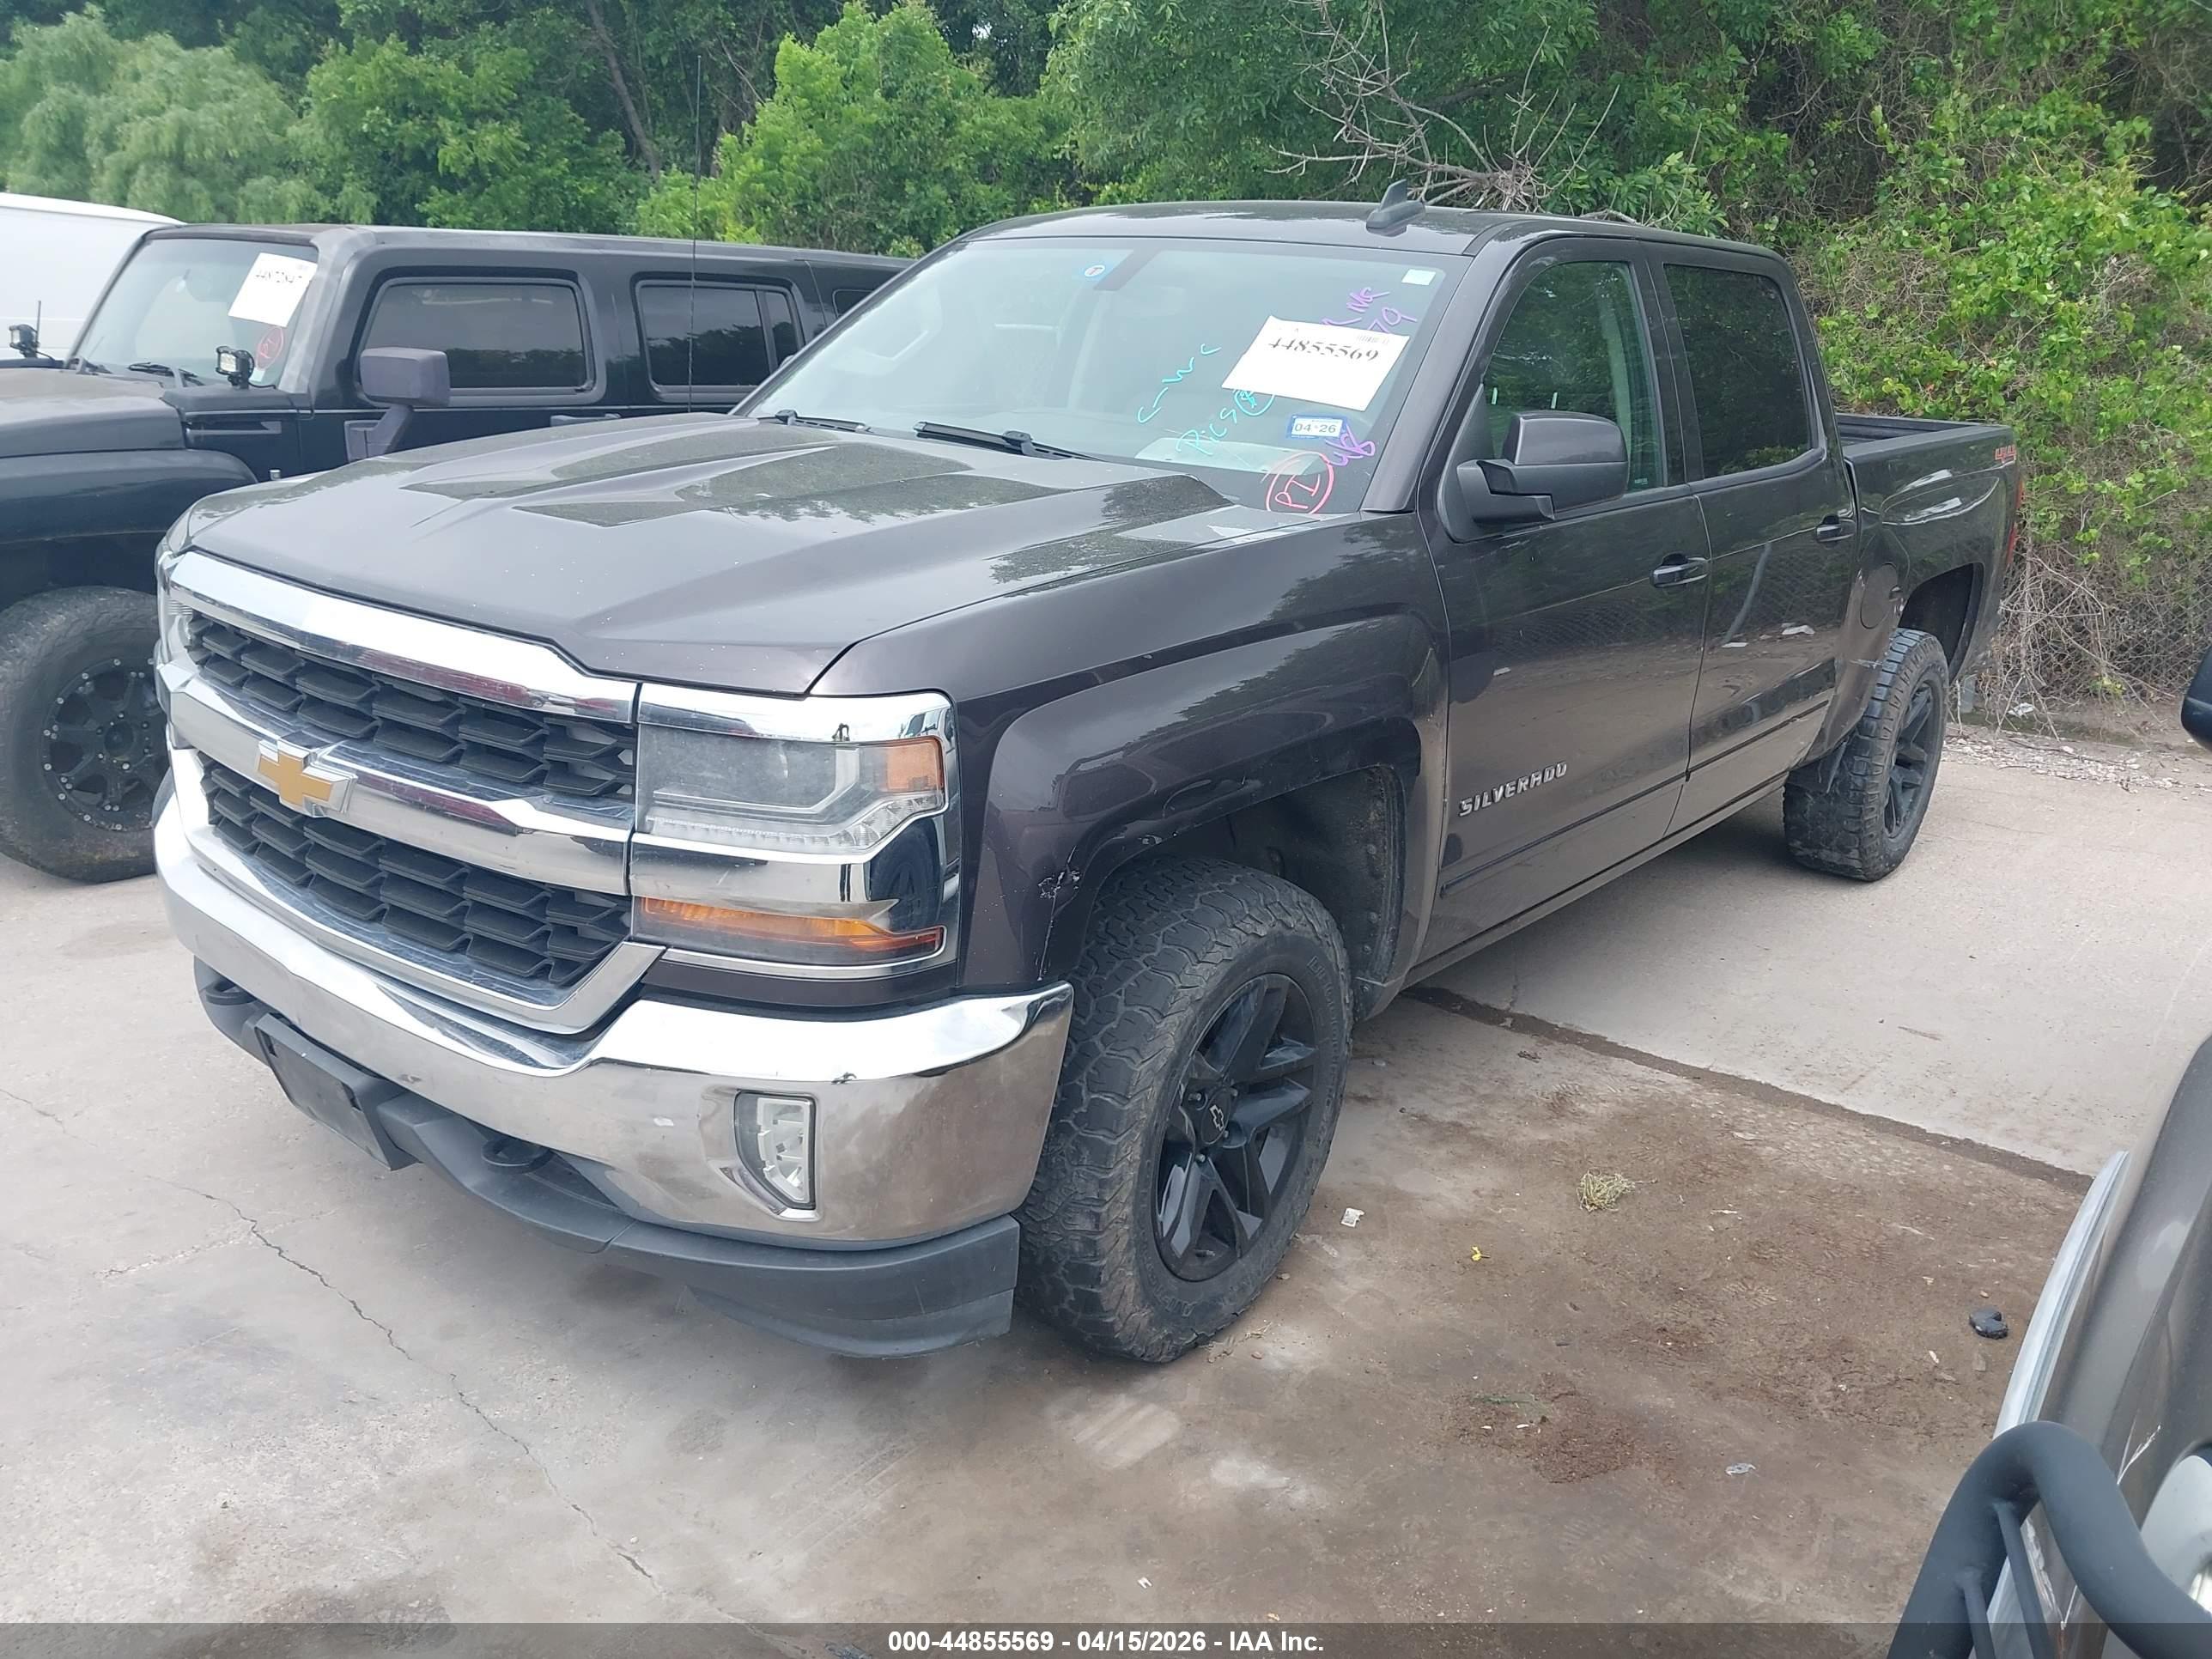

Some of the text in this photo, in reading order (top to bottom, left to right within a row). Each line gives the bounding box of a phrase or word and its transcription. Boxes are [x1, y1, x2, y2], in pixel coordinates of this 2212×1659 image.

[1268, 337, 1379, 361] 44855569
[1295, 423, 1338, 434] 04 26
[1459, 761, 1567, 817] SILVERADO
